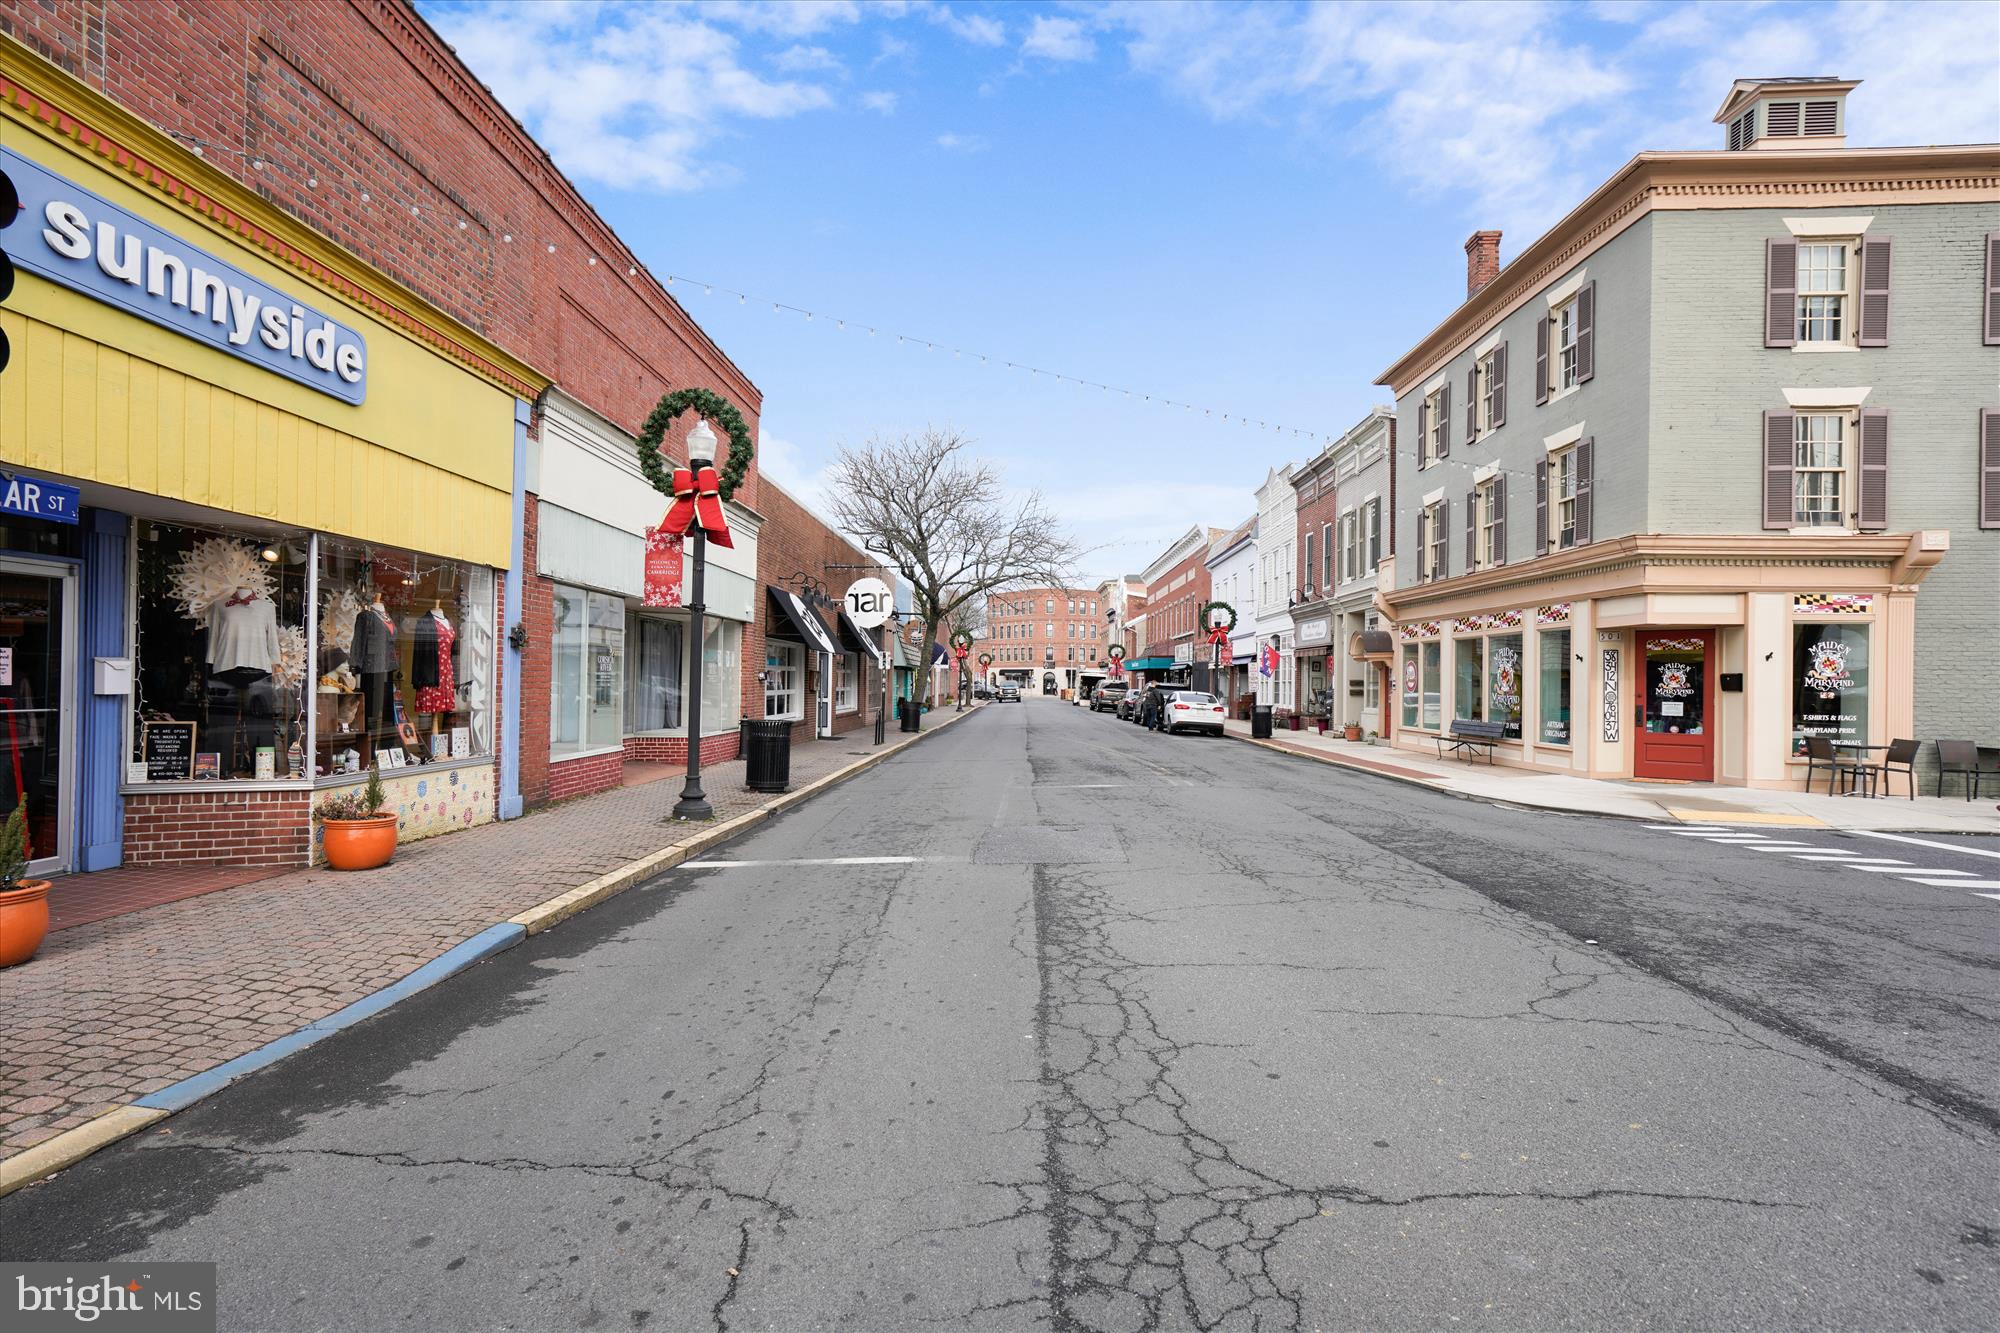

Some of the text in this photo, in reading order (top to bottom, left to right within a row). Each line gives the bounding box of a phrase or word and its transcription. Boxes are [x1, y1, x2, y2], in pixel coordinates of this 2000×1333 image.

[42, 201, 364, 383] sunnyside
[0, 480, 65, 513] AR ST
[1808, 641, 1852, 656] MAIDEN
[1264, 646, 1272, 674] OPEN
[1658, 662, 1692, 673] MAIDEN
[1804, 677, 1855, 691] MARYLAND
[1655, 688, 1695, 698] MARYLAND
[1547, 721, 1564, 729] ARTISAN
[1545, 730, 1567, 738] ORIGINALS
